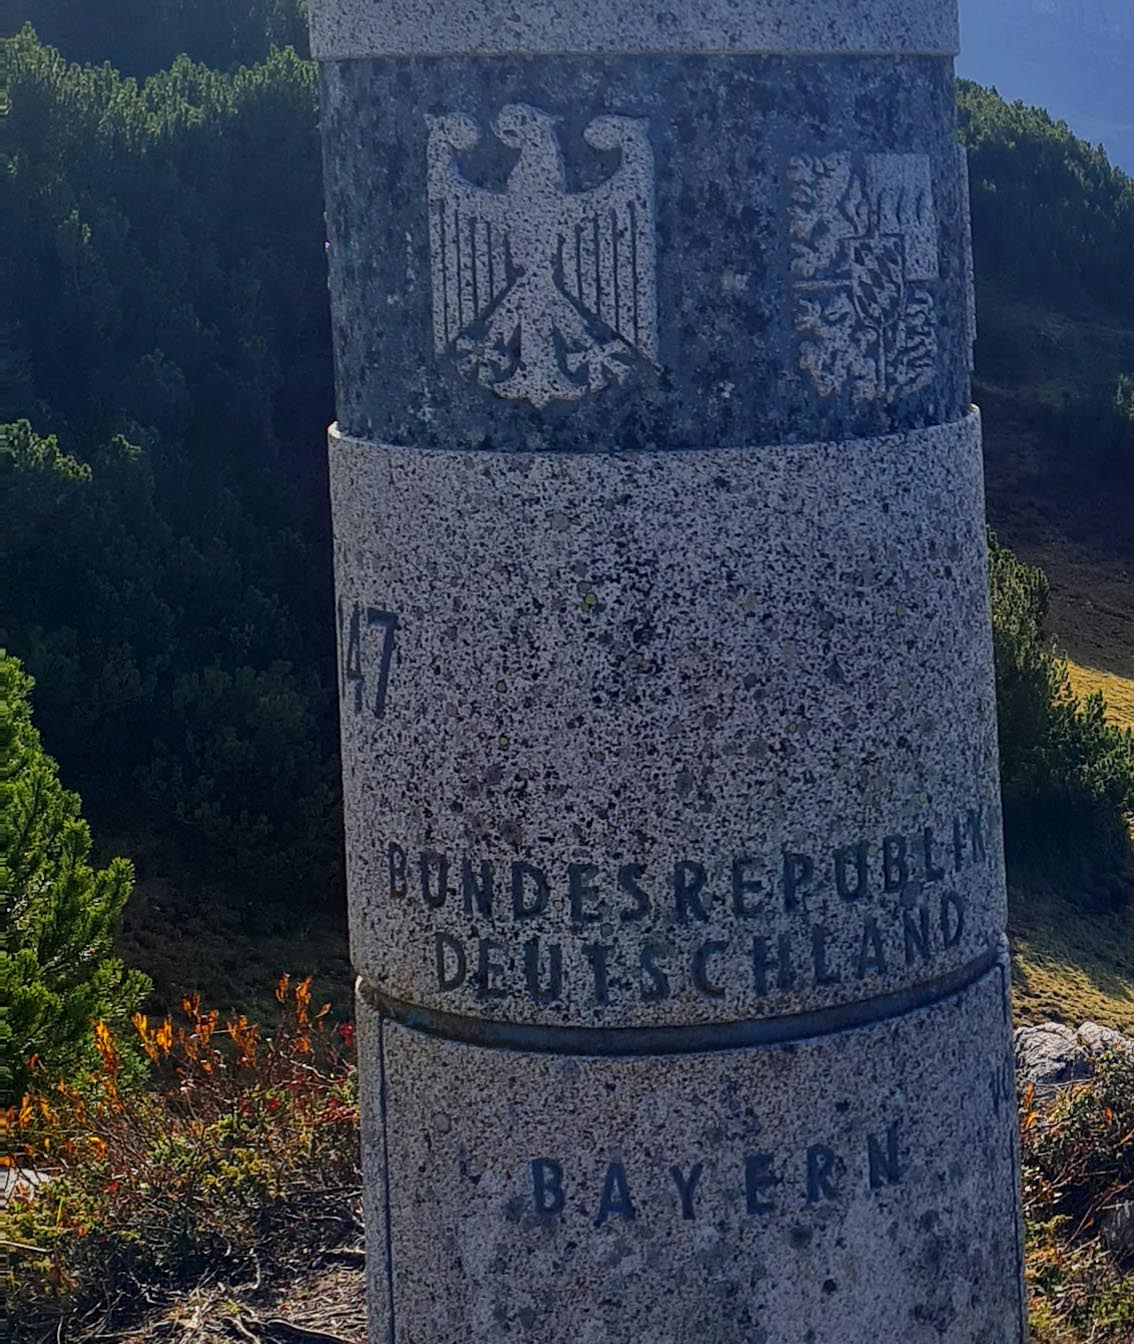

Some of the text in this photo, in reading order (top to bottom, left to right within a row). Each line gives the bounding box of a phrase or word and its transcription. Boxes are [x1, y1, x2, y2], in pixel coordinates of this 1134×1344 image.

[388, 802, 988, 925] BUNDESREPUBLIK
[435, 893, 965, 1002] DEUTSCHLAND
[532, 1131, 901, 1222] BAYERN
